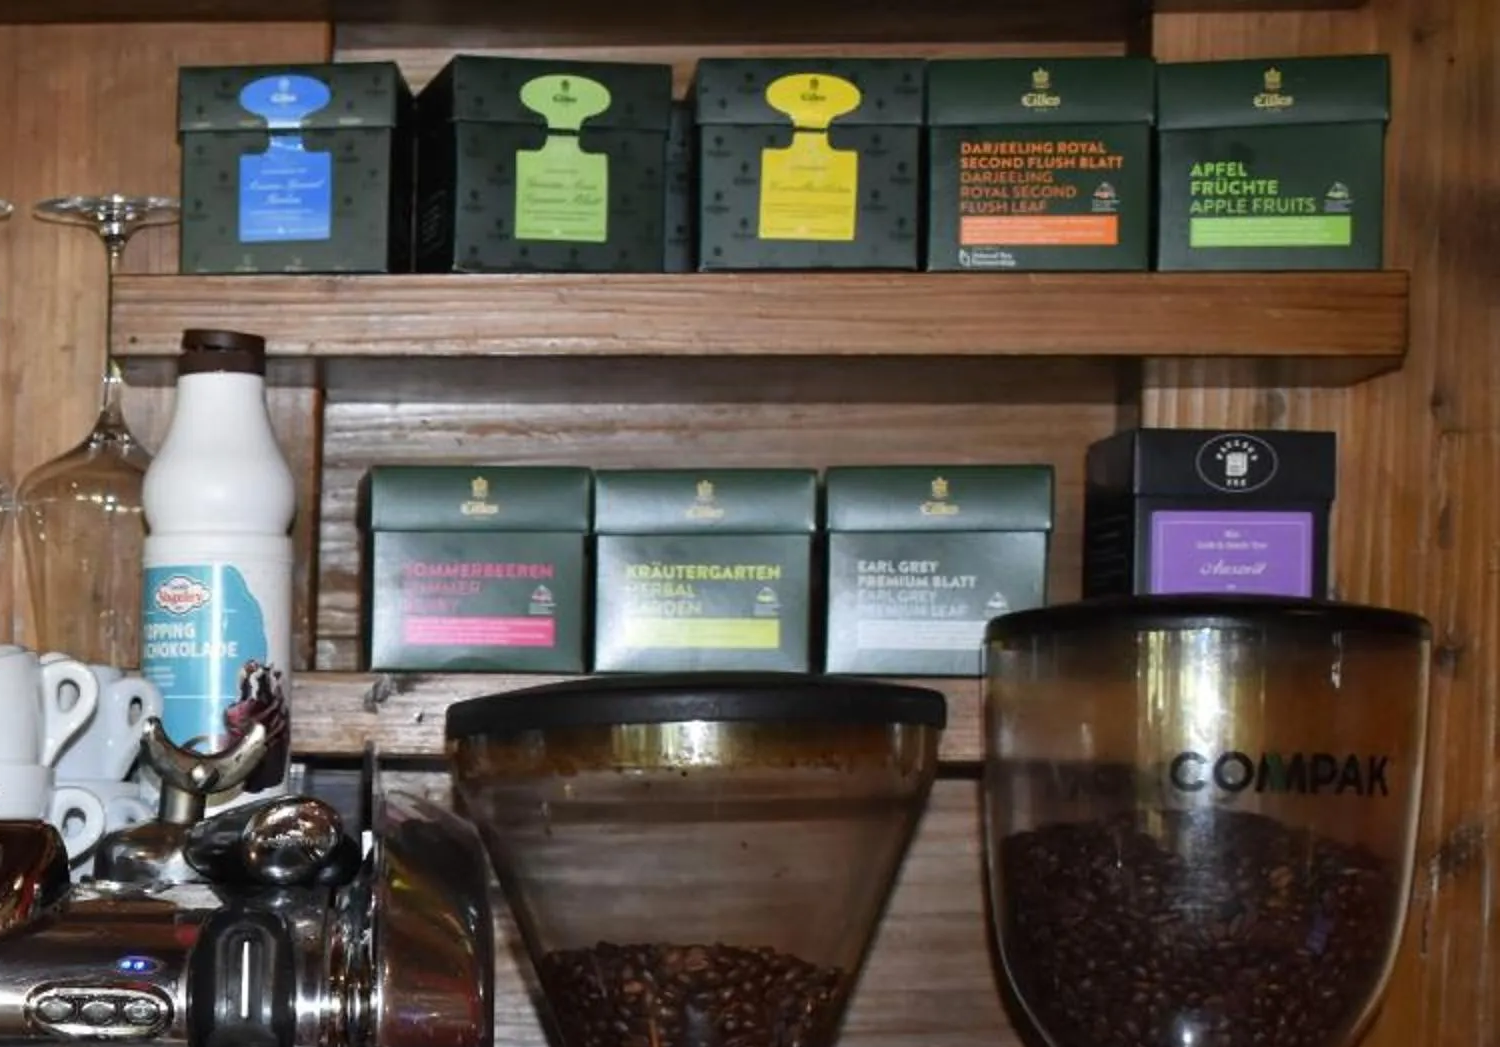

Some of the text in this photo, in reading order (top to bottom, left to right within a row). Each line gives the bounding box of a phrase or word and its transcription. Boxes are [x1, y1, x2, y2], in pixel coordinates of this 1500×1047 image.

[960, 141, 1106, 154] DARJEELING ROYAL
[960, 155, 1124, 169] SECOND FLUSH BLATT
[1189, 161, 1247, 177] APFEL
[960, 171, 1053, 184] DARJEELING
[960, 185, 1077, 198] ROYAL SECOND
[1190, 177, 1278, 196] FRÜCHTE
[960, 200, 1048, 213] FLUSH LEAF
[1189, 198, 1246, 214] APPLE
[1251, 197, 1317, 214] FRUITS
[626, 561, 781, 580] KRÄUTERGARTEN
[857, 560, 940, 573] EARL GREY
[857, 575, 977, 588] PREMIUM BLATT
[148, 622, 195, 640] PPING
[1170, 751, 1390, 797] COMPAK
